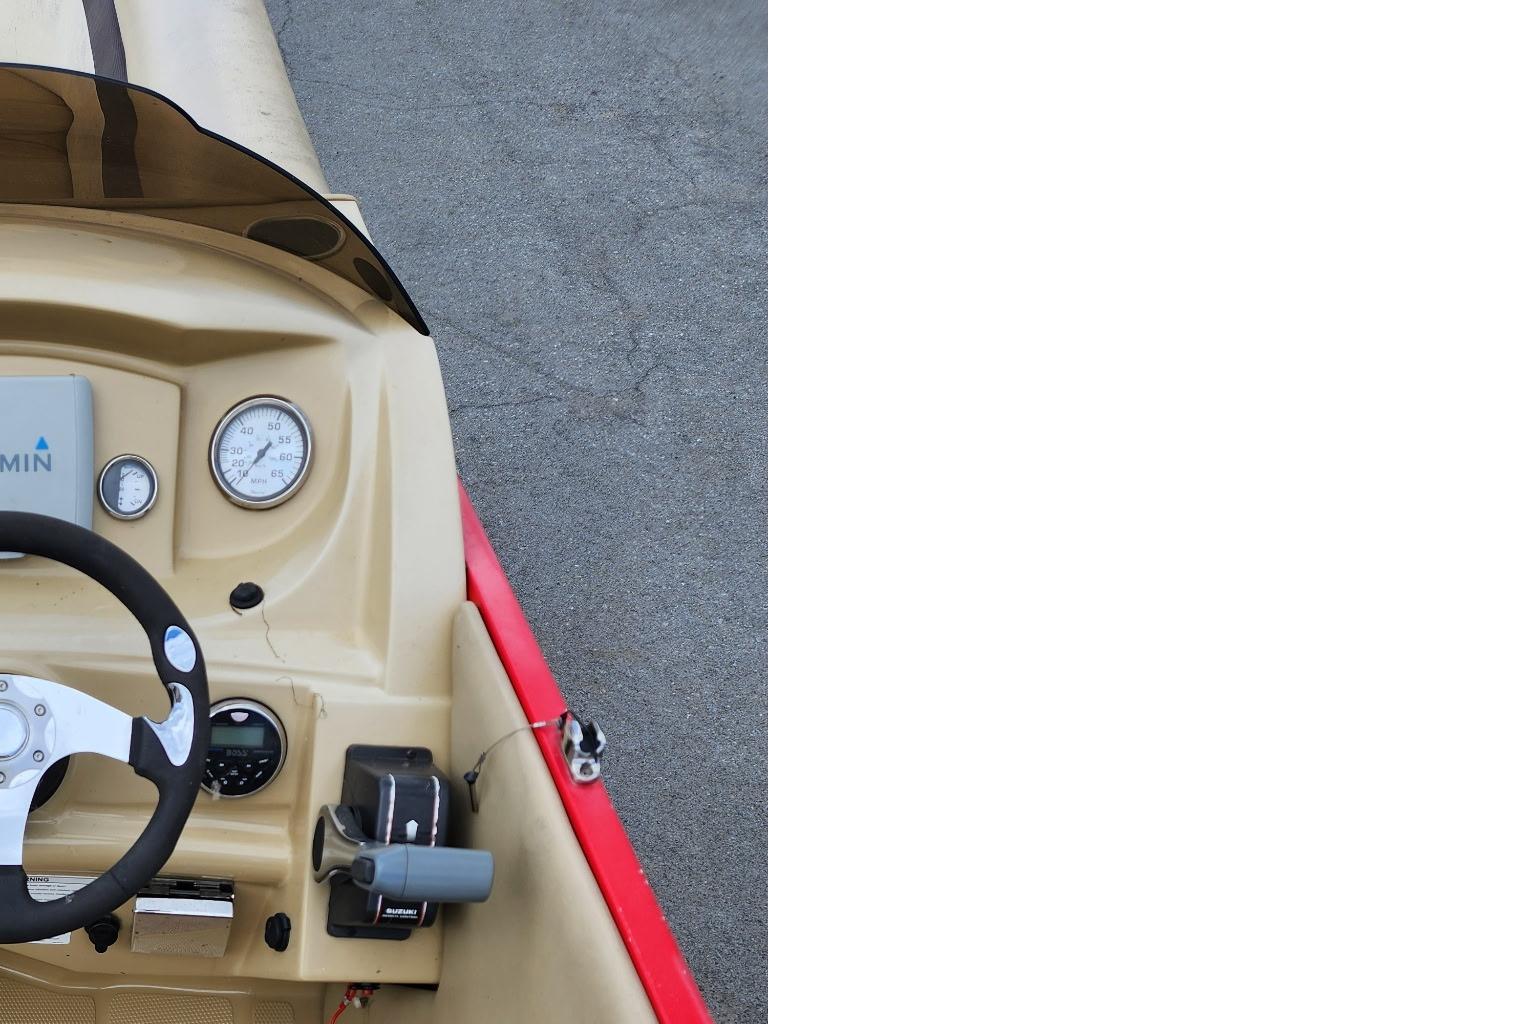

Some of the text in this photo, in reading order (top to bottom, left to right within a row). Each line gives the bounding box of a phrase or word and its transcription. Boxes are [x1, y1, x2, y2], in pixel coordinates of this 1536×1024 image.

[240, 426, 254, 435] 40
[267, 422, 281, 431] 50
[278, 435, 291, 444] 55
[230, 446, 243, 455] 30
[279, 452, 293, 461] 60
[231, 458, 245, 467] 20
[238, 469, 249, 478] 10
[271, 469, 284, 478] 65
